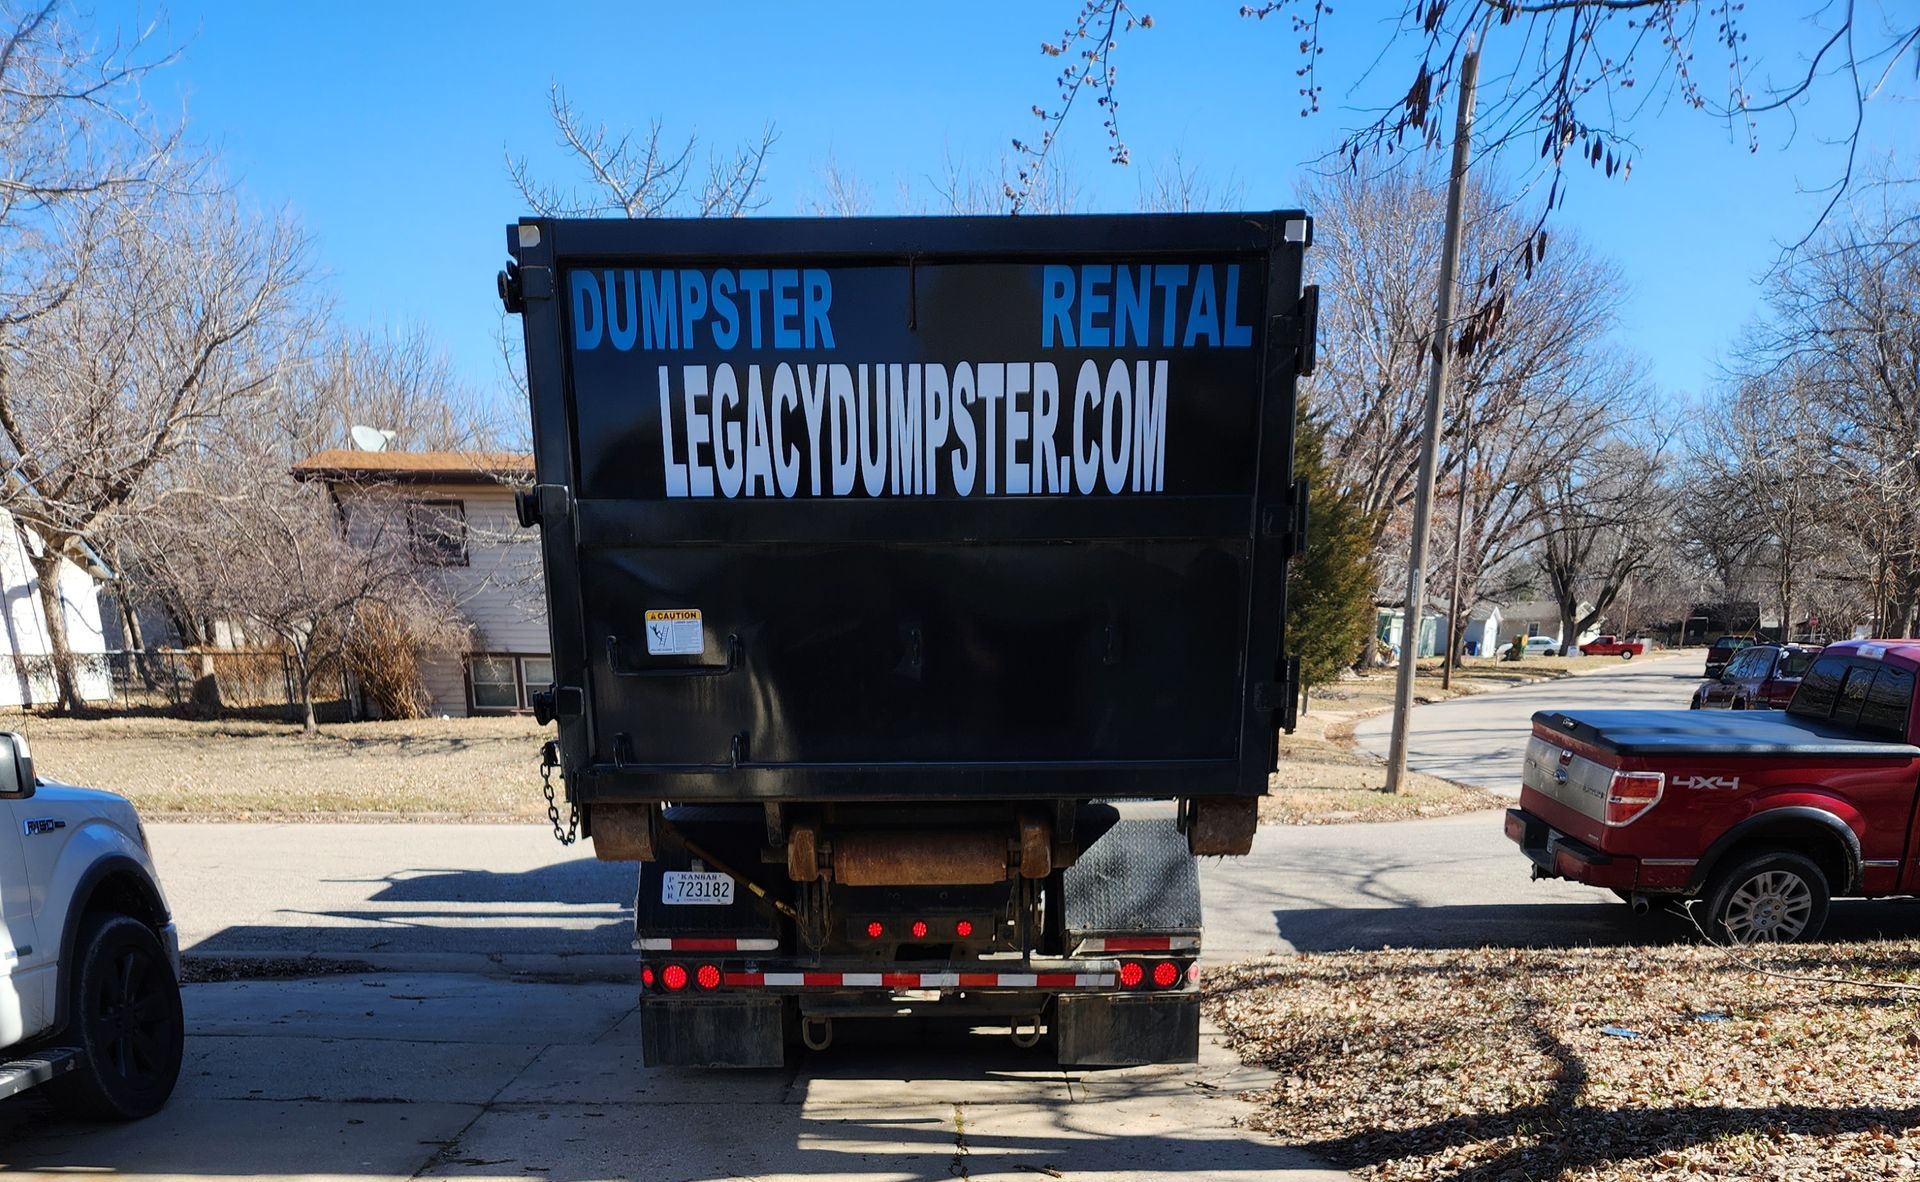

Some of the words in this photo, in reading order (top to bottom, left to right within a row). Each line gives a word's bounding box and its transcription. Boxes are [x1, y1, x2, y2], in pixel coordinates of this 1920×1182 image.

[571, 269, 836, 351] DUMPSTER
[1041, 266, 1252, 348] RENTAL
[658, 358, 1169, 498] LEGACYDUMPSTER.COM
[657, 611, 697, 620] CAUTION
[678, 881, 729, 897] 723182
